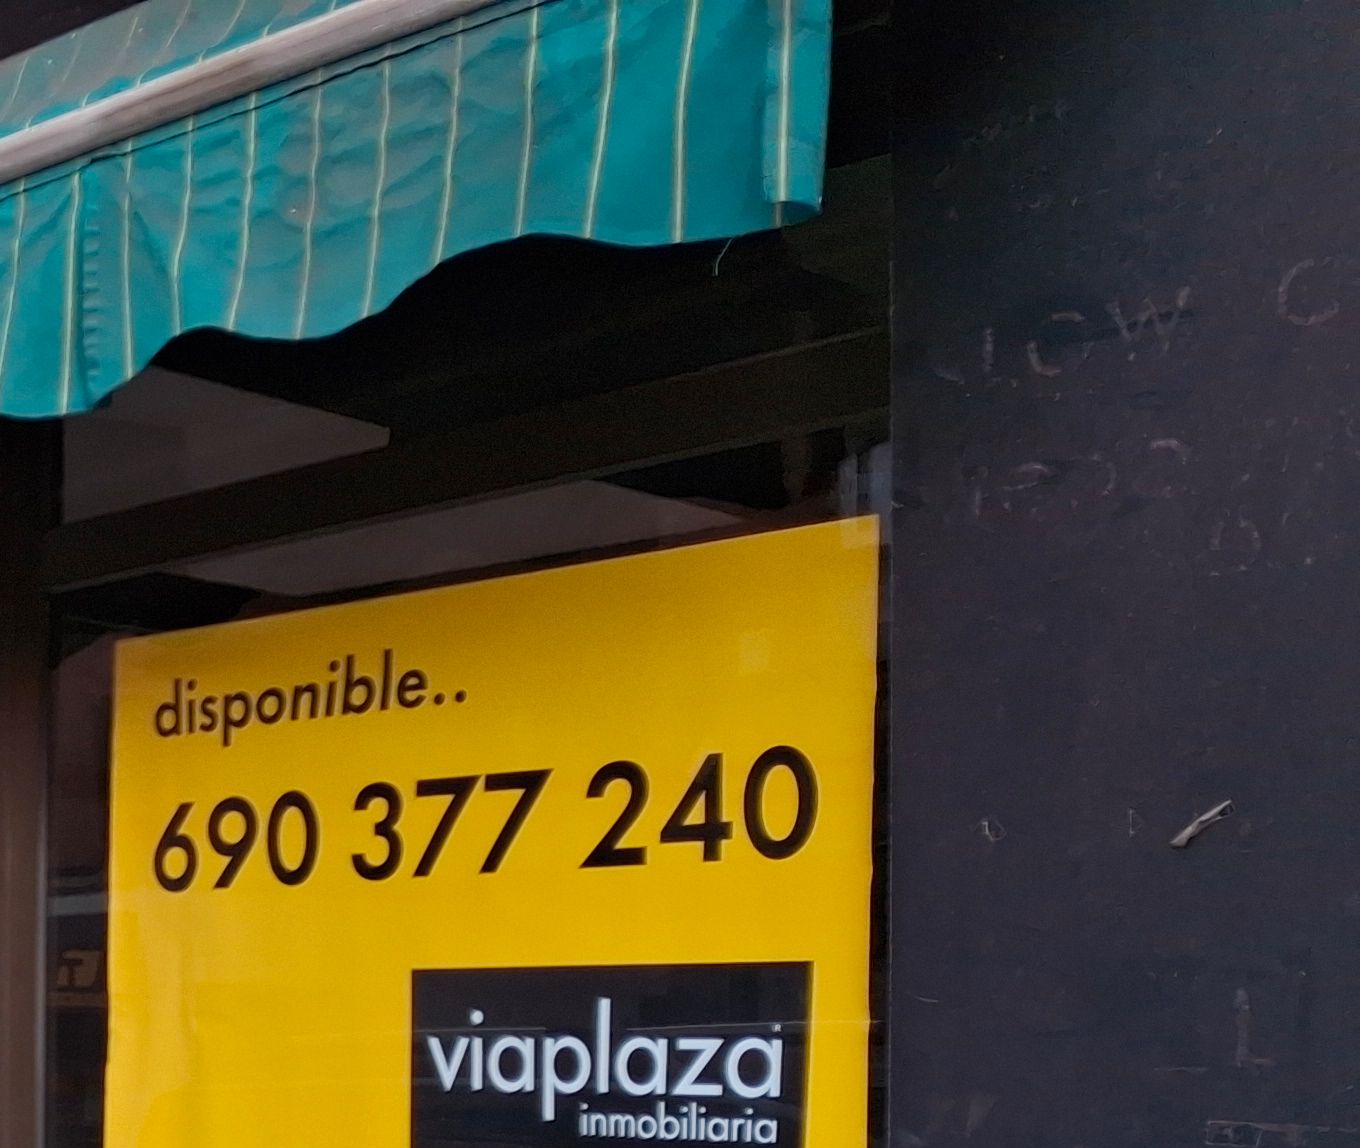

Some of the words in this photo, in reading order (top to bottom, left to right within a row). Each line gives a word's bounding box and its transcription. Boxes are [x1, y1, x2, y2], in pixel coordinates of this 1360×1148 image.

[153, 790, 319, 893] 690
[351, 768, 552, 881] 377
[579, 745, 818, 869] 240
[427, 997, 783, 1122] viaplaza
[579, 1103, 778, 1145] inmobiliaria
